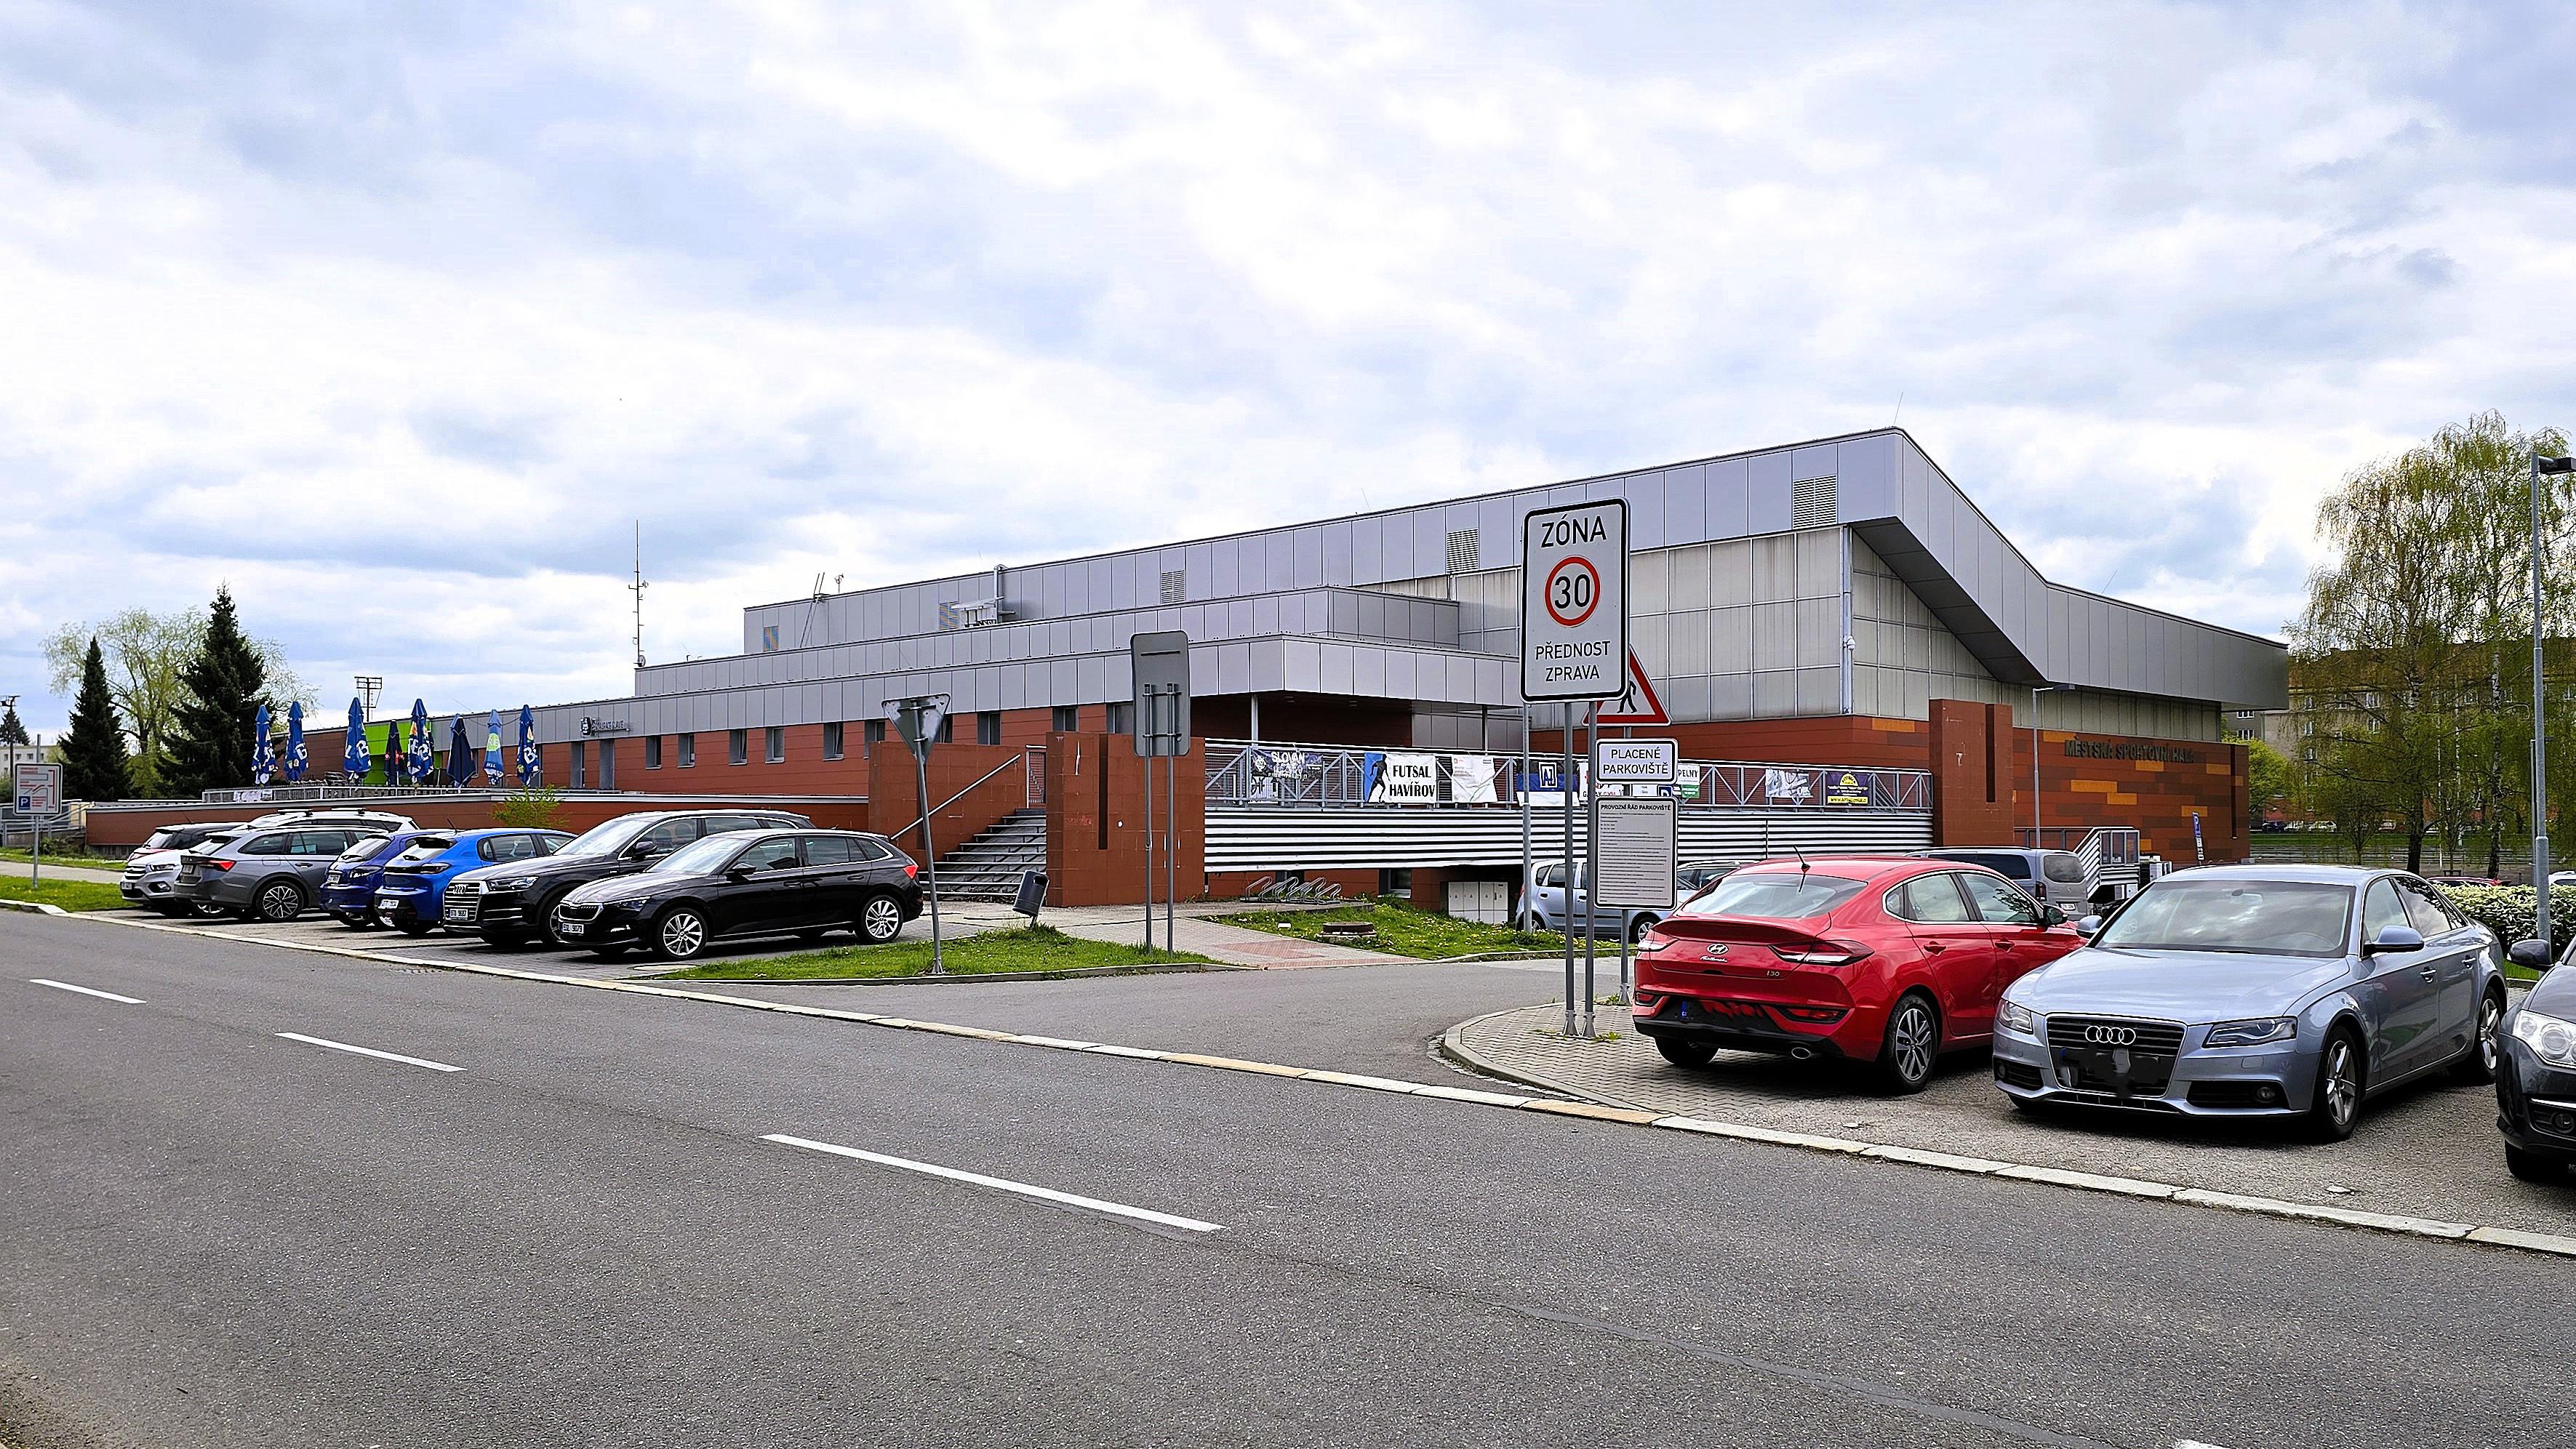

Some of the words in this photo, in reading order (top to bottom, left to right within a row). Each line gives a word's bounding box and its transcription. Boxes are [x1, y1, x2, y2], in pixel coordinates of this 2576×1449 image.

[1541, 514, 1607, 547] ZÓNA
[1554, 574, 1591, 609] 30
[1535, 641, 1611, 660] PŘEDNOST
[1545, 665, 1600, 682] ZPRAVA
[1611, 746, 1661, 759] PLACENÉ
[2065, 736, 2114, 758] MĚSTSKÁ
[1393, 765, 1432, 778] FUTSAL
[1603, 761, 1668, 774] PARKOVIŠTĚ
[1389, 781, 1436, 798] HAVÍŘOV
